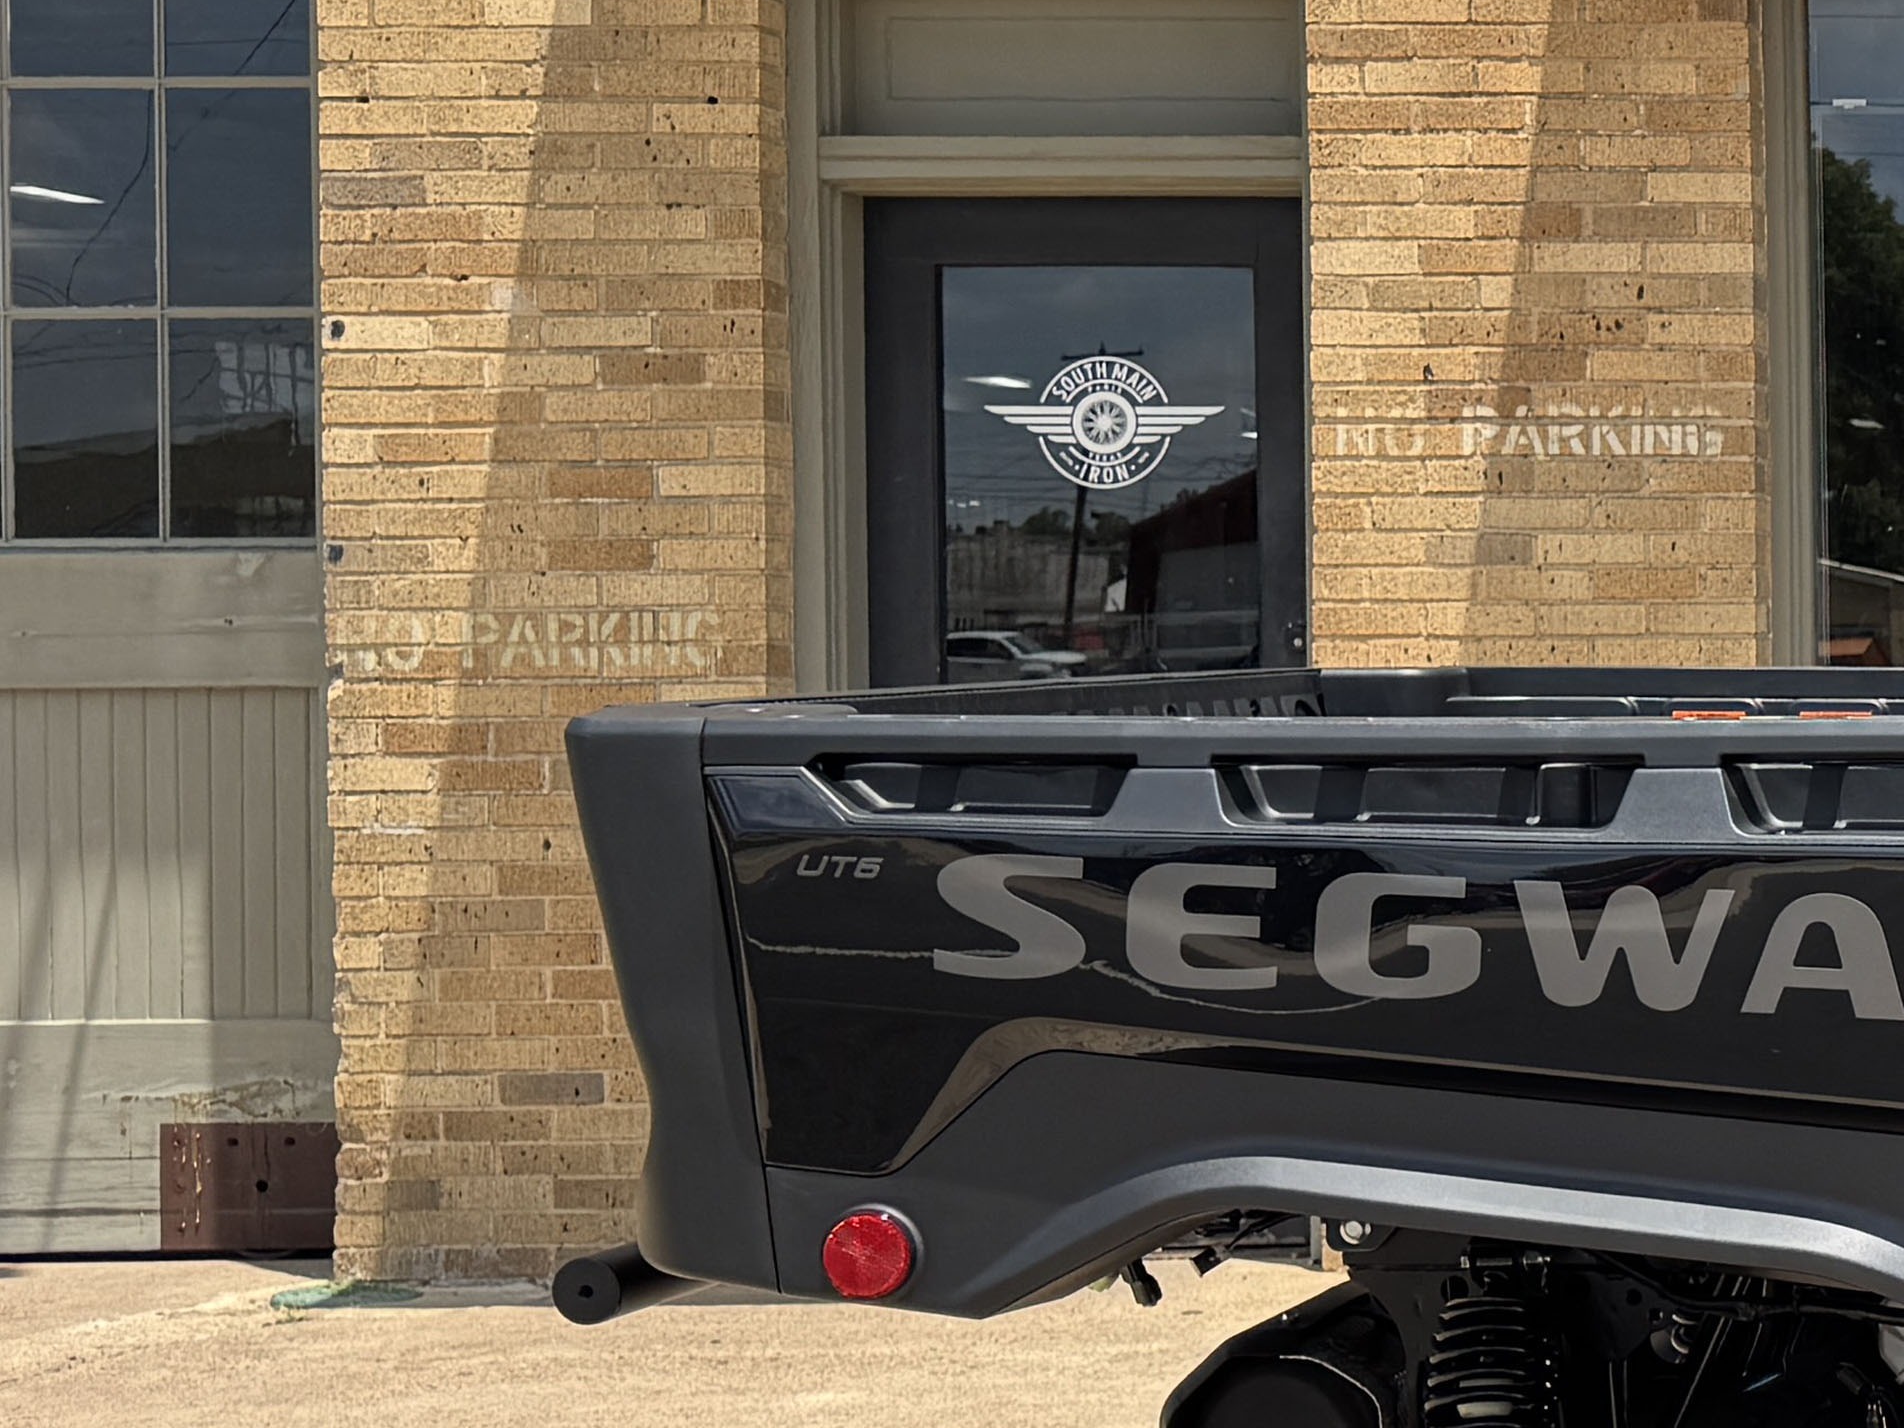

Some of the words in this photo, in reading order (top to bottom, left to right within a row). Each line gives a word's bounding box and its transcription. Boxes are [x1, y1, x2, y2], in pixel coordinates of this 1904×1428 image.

[1052, 361, 1107, 402] SOUTH
[1111, 364, 1158, 402] MAIN
[1462, 403, 1724, 458] PARKING
[1079, 463, 1130, 483] IRON
[461, 609, 721, 670] PARKING
[796, 853, 884, 879] UT6
